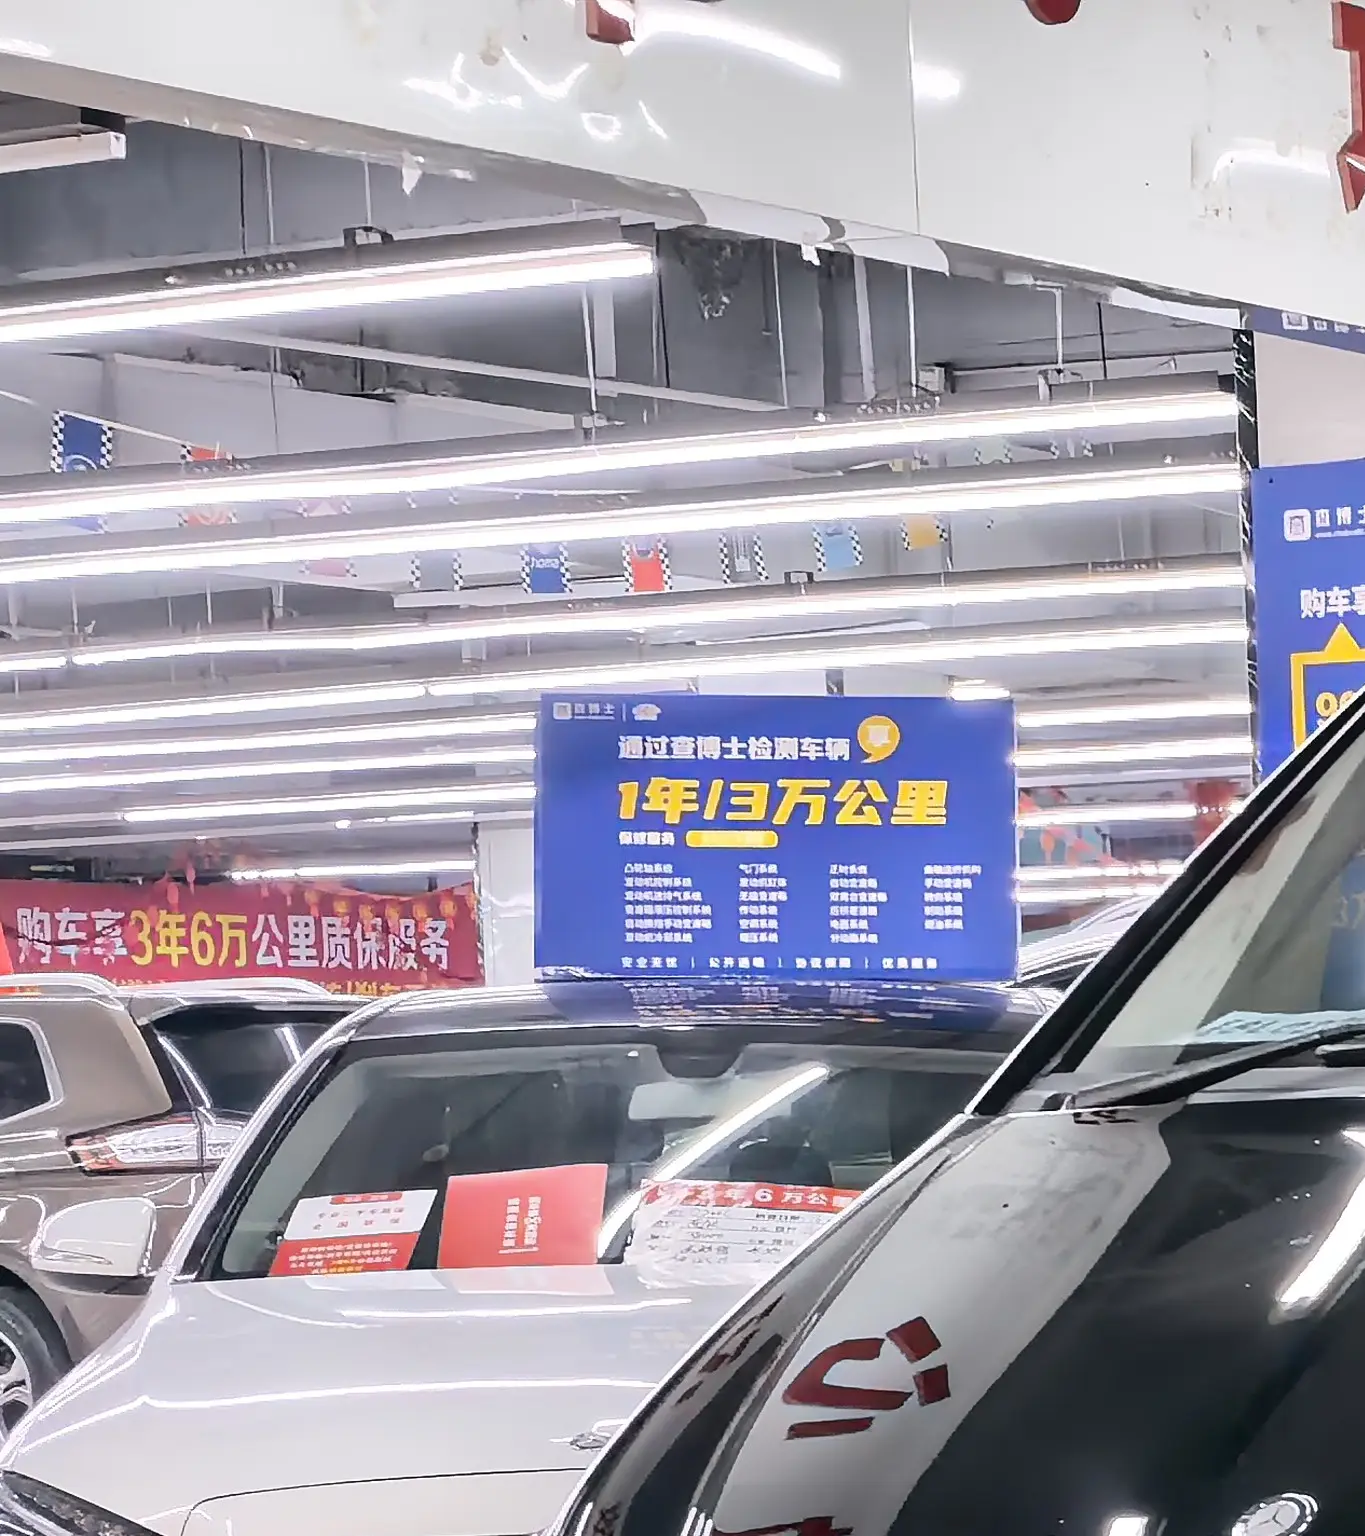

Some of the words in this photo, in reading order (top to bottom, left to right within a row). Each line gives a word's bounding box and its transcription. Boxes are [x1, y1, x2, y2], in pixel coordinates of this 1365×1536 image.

[617, 735, 852, 762] 通过查博士检测车辆
[617, 776, 948, 826] 1年/3万公里
[15, 905, 450, 972] 购车享3年6万公里质保服务
